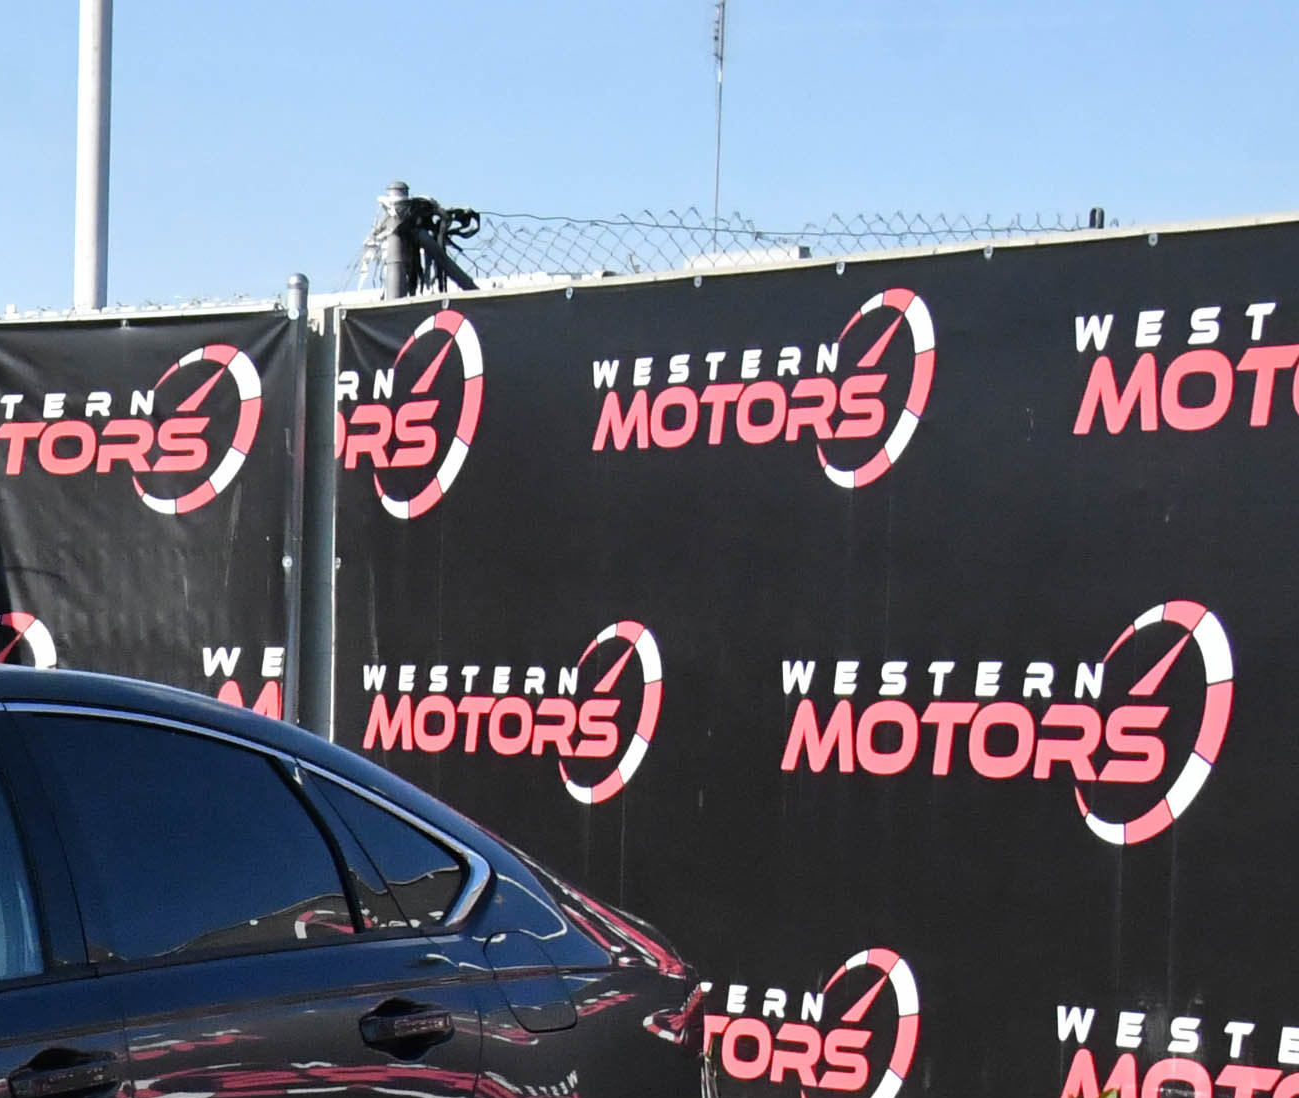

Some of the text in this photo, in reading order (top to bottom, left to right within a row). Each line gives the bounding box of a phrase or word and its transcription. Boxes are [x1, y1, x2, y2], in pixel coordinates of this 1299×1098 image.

[1074, 302, 1277, 353] WEST
[592, 342, 840, 389] WESTERN
[1072, 343, 1299, 436] MOT
[335, 399, 441, 470] RS
[592, 373, 889, 452] MOTORS
[362, 664, 579, 696] WESTERN
[781, 660, 1105, 700] WESTERN
[362, 692, 622, 759] MOTORS
[780, 697, 1171, 784] MOTORS
[700, 981, 825, 1023] ERN
